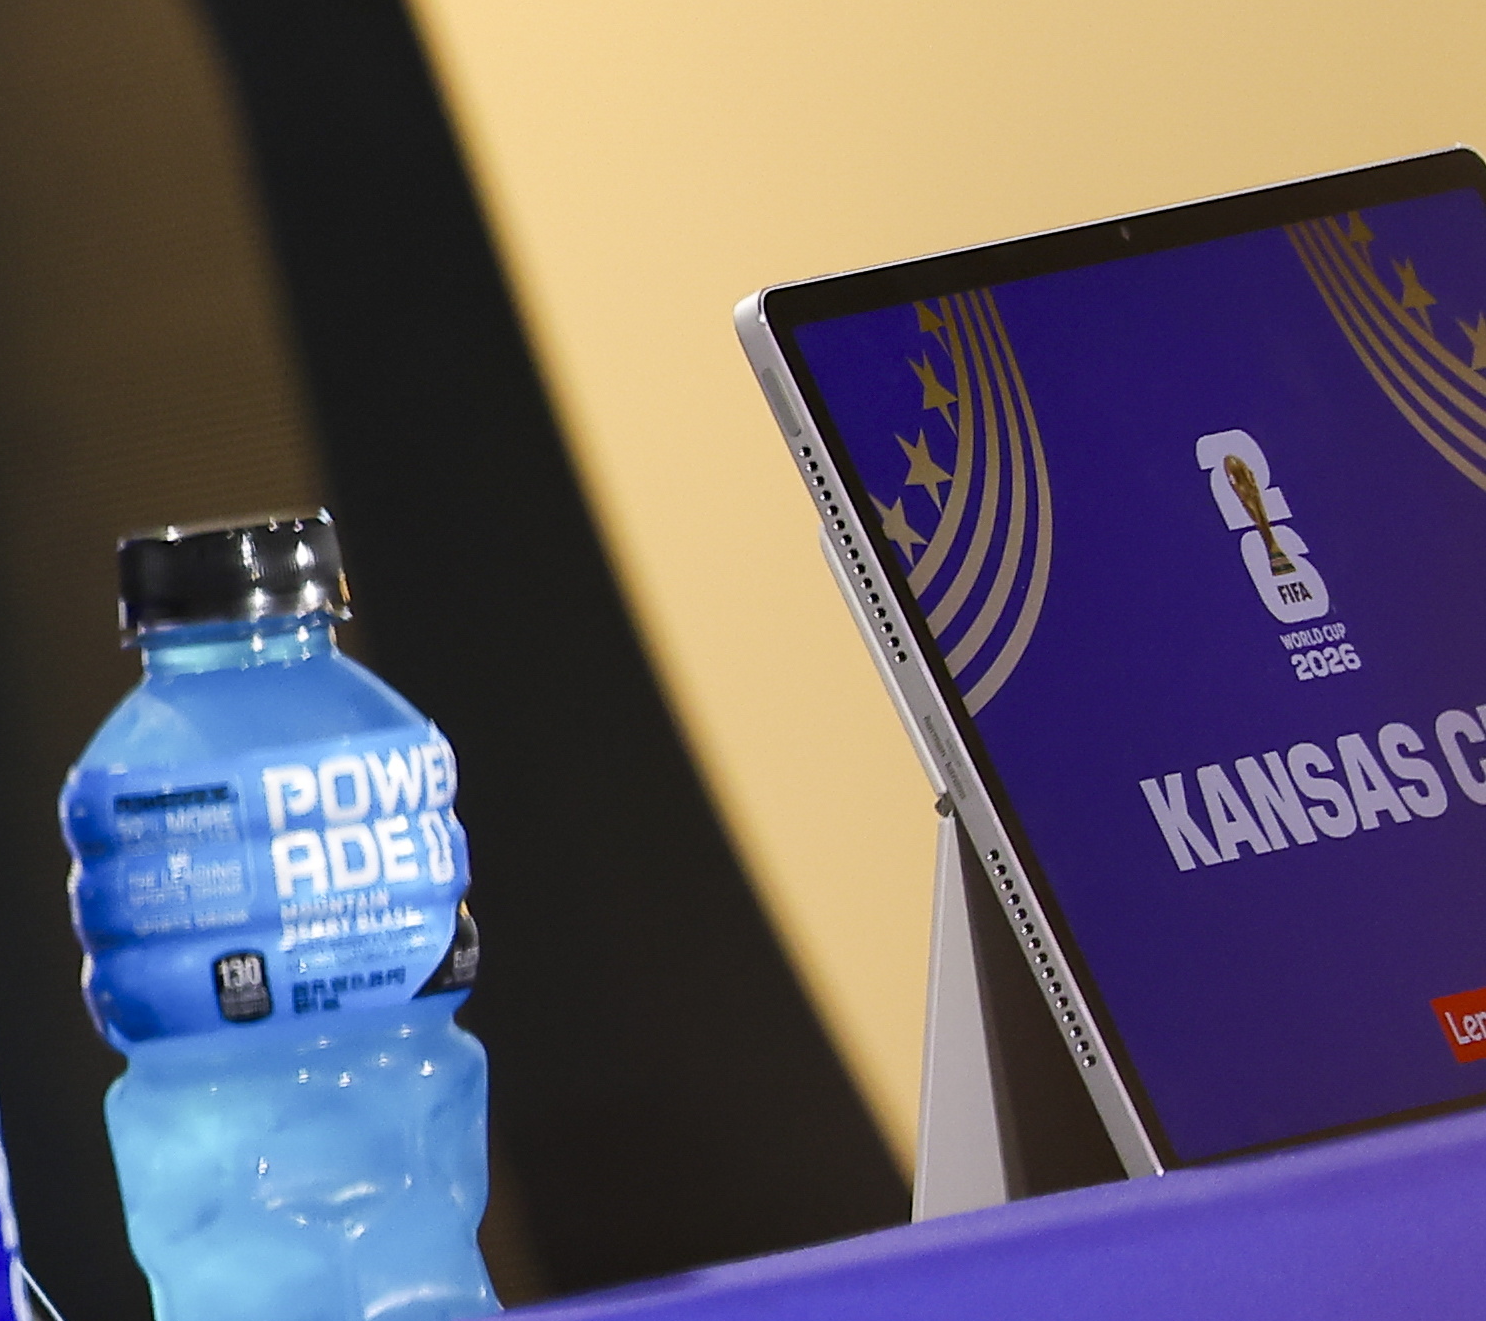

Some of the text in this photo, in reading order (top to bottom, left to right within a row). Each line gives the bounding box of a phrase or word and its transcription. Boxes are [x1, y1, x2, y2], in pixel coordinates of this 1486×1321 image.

[1277, 581, 1313, 606] FIFA
[1279, 621, 1347, 651] WORLD CUP
[1291, 642, 1363, 682] 2026
[1138, 703, 1486, 872] KANSAS C
[270, 813, 420, 899] ADE
[219, 953, 263, 993] 130
